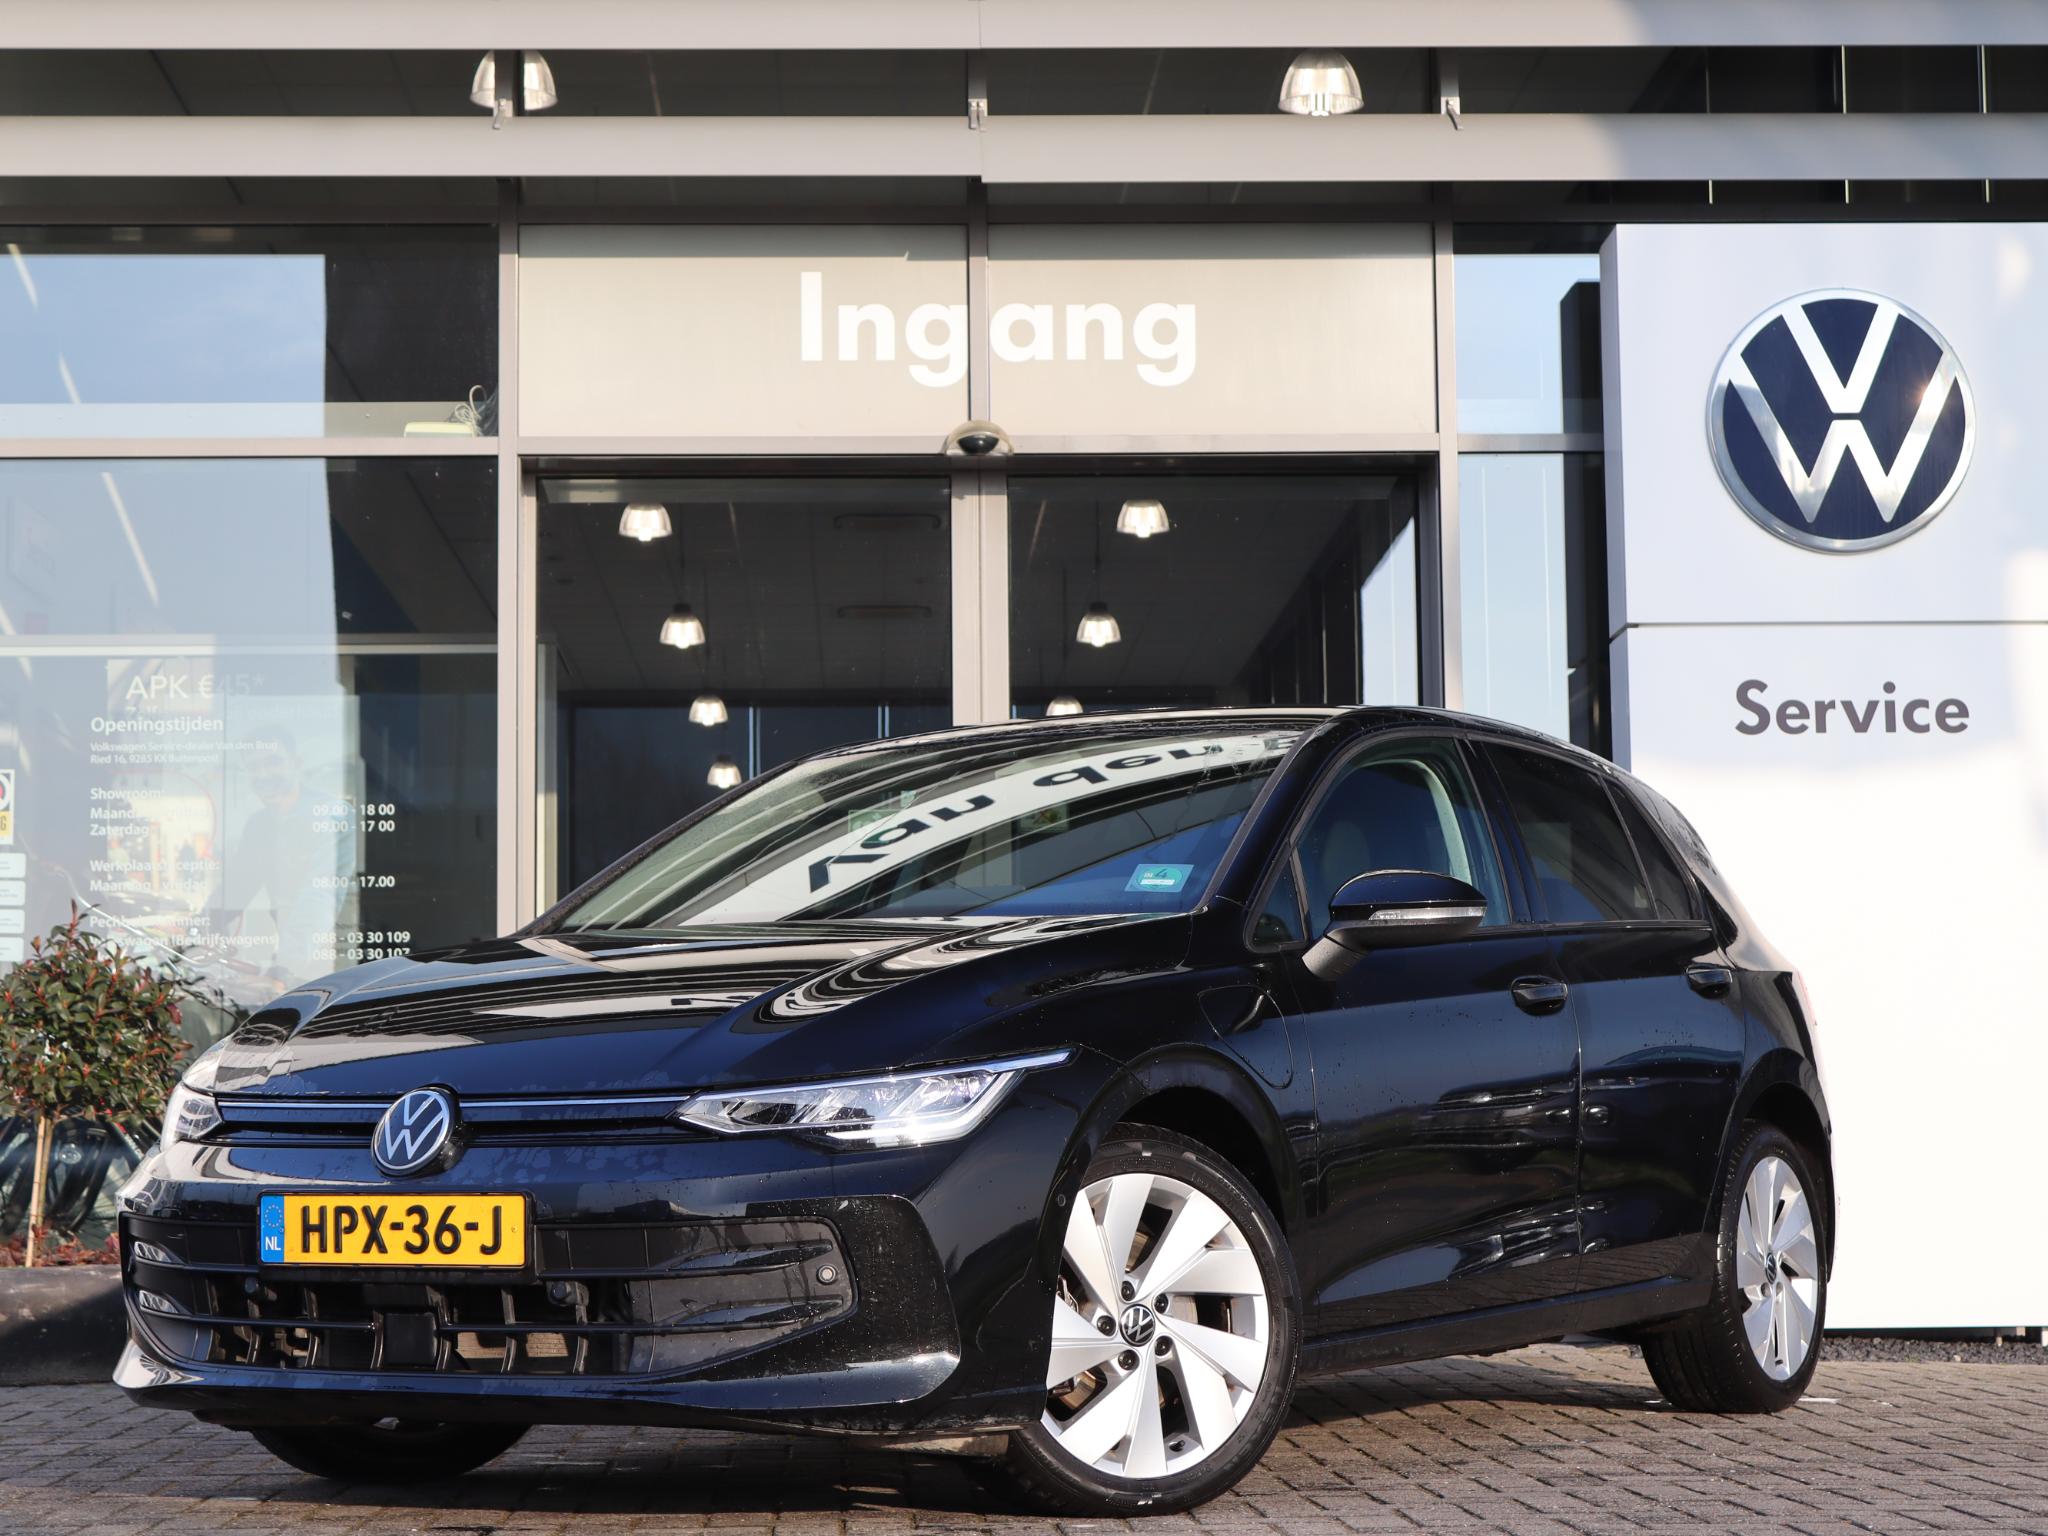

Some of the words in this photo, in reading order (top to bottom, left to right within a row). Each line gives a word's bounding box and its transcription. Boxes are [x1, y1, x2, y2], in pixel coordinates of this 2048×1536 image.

[799, 271, 1197, 388] Ingang
[126, 674, 190, 700] APK
[1734, 679, 1971, 736] Service
[90, 716, 224, 735] Openingstijden
[360, 875, 396, 888] 17.00
[312, 931, 336, 944] 088
[347, 931, 363, 944] 03
[366, 931, 383, 944] 30
[387, 931, 411, 944] 109
[312, 948, 337, 960] 088
[347, 948, 363, 960] 03
[366, 948, 383, 960] 30
[300, 1204, 503, 1257] HPX-36-J
[264, 1236, 281, 1251] NL
